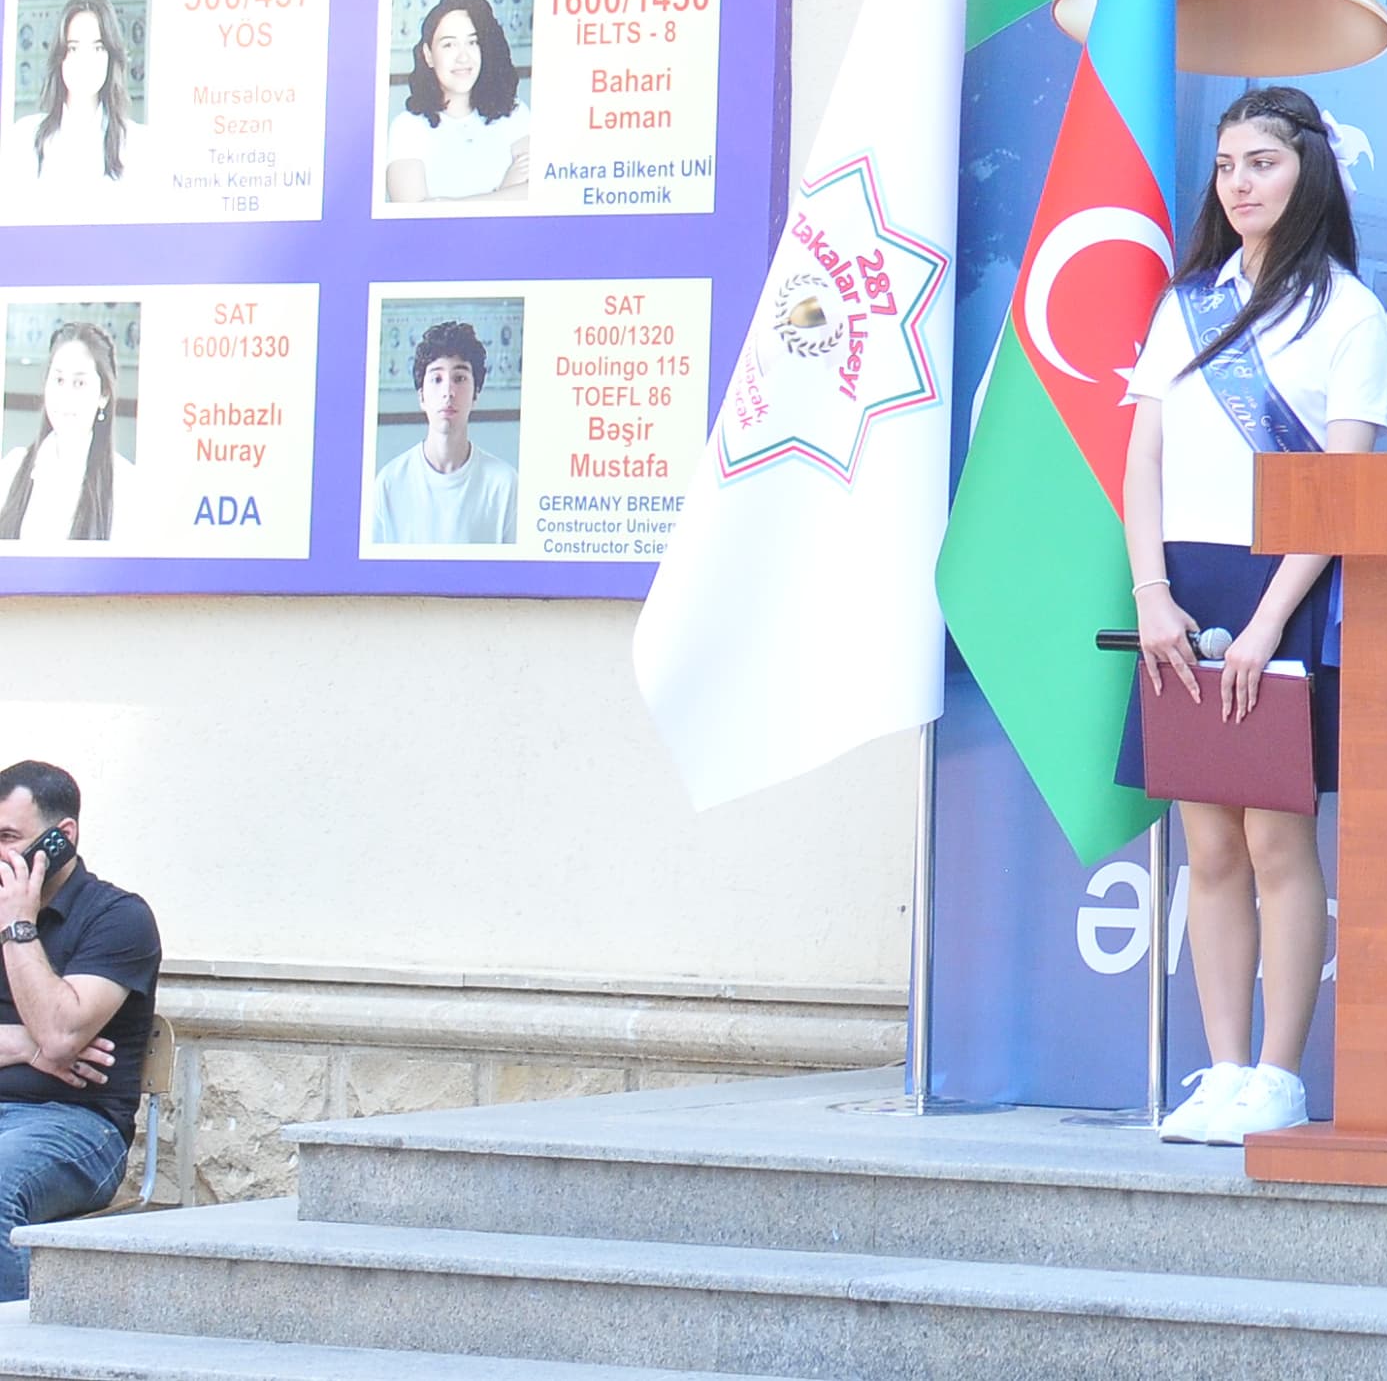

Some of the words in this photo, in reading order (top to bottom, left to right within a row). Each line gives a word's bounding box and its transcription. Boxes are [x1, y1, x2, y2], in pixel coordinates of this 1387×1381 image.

[664, 20, 676, 42] 8
[592, 67, 671, 93] Bahari
[589, 106, 671, 130] Ləman
[227, 171, 277, 187] Kemal
[543, 162, 607, 180] Ankara
[613, 160, 675, 179] Bilkent
[681, 155, 713, 177] UNİ
[583, 186, 672, 206] Ekonomik
[856, 249, 898, 316] 287
[214, 302, 258, 325] SAT
[604, 295, 646, 316] SAT
[181, 335, 290, 358] 1600/1330
[574, 325, 674, 346] 1600/1320
[556, 356, 648, 381] Duolingo
[656, 356, 690, 377] 115
[571, 386, 641, 407] TOEFL
[648, 386, 672, 407] 86
[182, 402, 282, 432] Şahbazlı
[588, 416, 654, 448] Bəşir
[196, 438, 267, 468] Nuray
[570, 453, 669, 479] Mustafa
[193, 495, 262, 526] ADA
[539, 495, 622, 513] GERMANY
[536, 518, 621, 534] Constructor
[543, 539, 630, 555] Constructor
